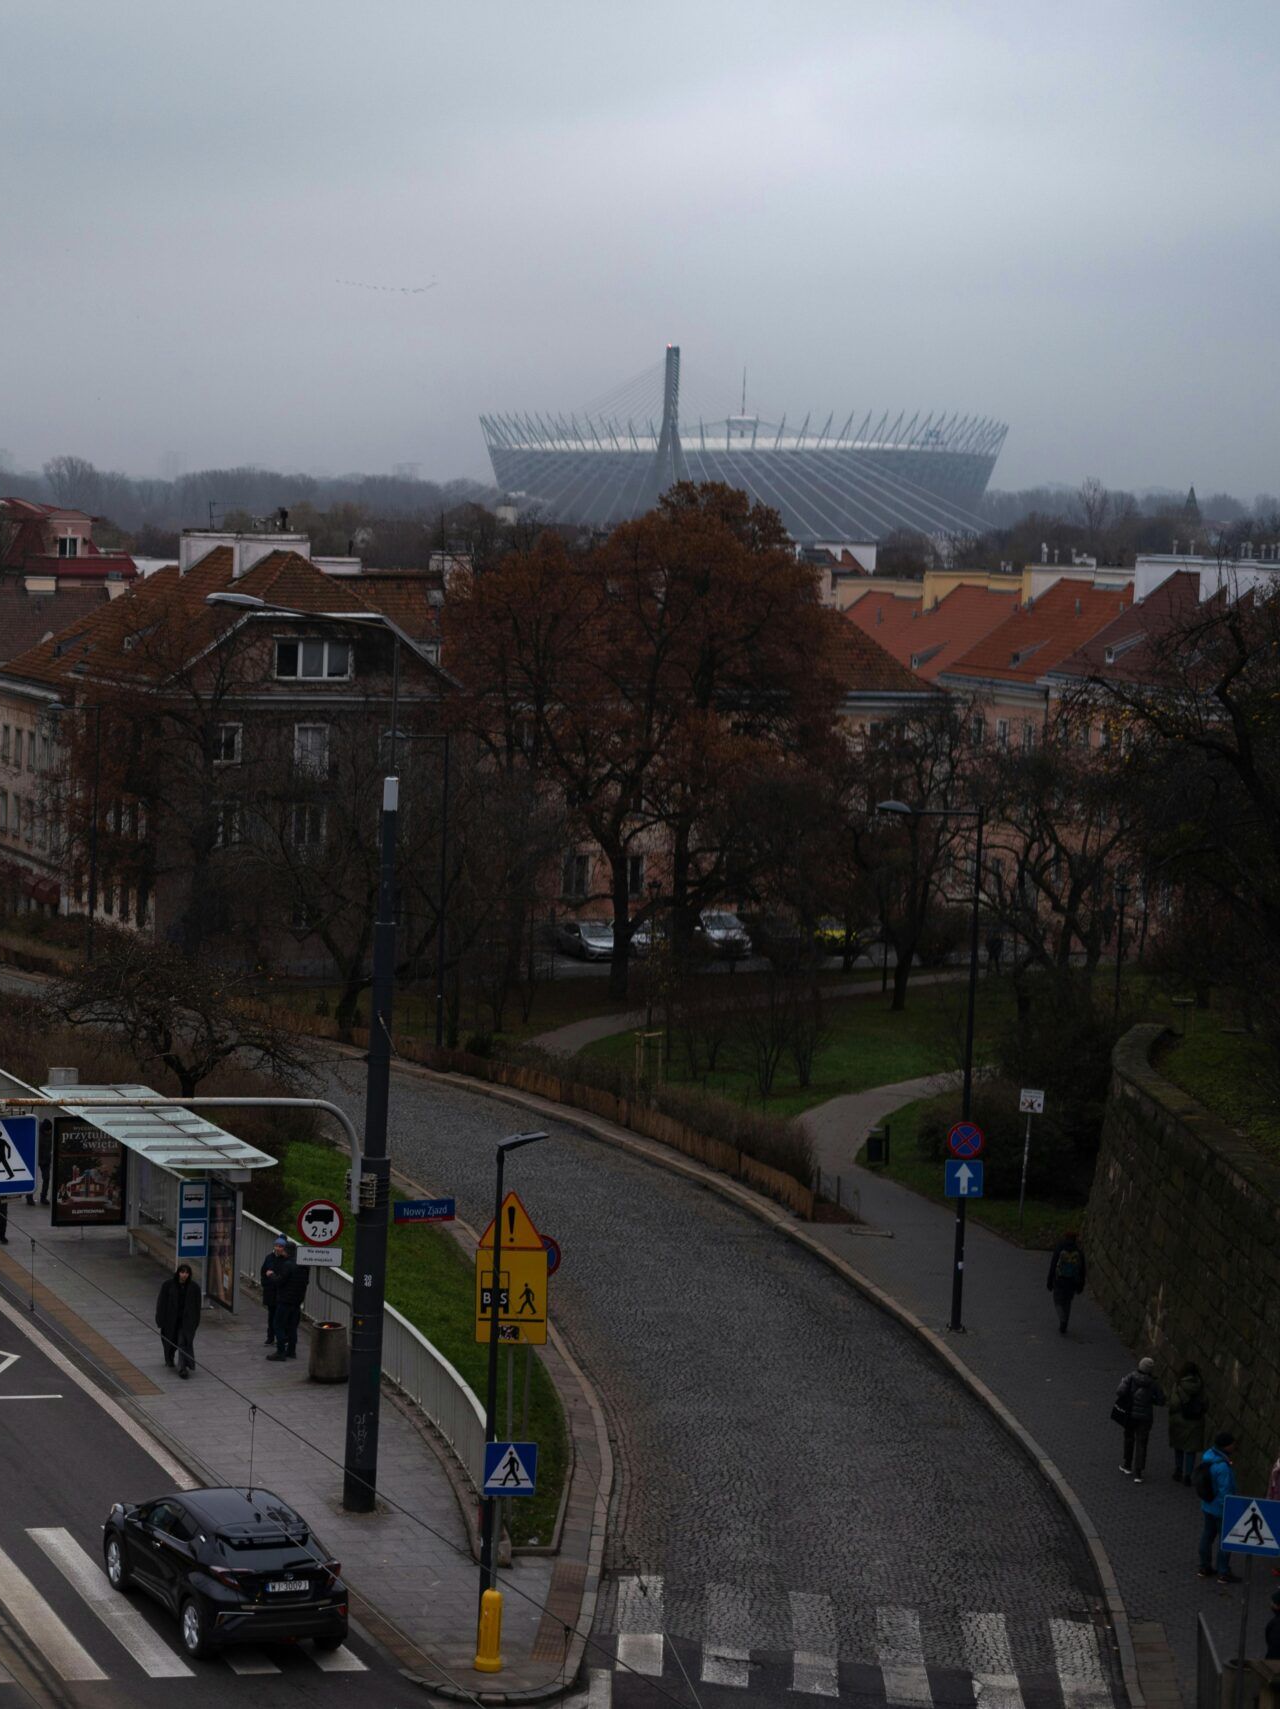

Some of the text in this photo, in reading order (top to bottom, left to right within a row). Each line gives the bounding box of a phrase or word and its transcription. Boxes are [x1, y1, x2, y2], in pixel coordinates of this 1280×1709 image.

[403, 1205, 448, 1217] Nowy Zjazd
[311, 1226, 327, 1237] 2,5
[483, 1292, 508, 1304] BS
